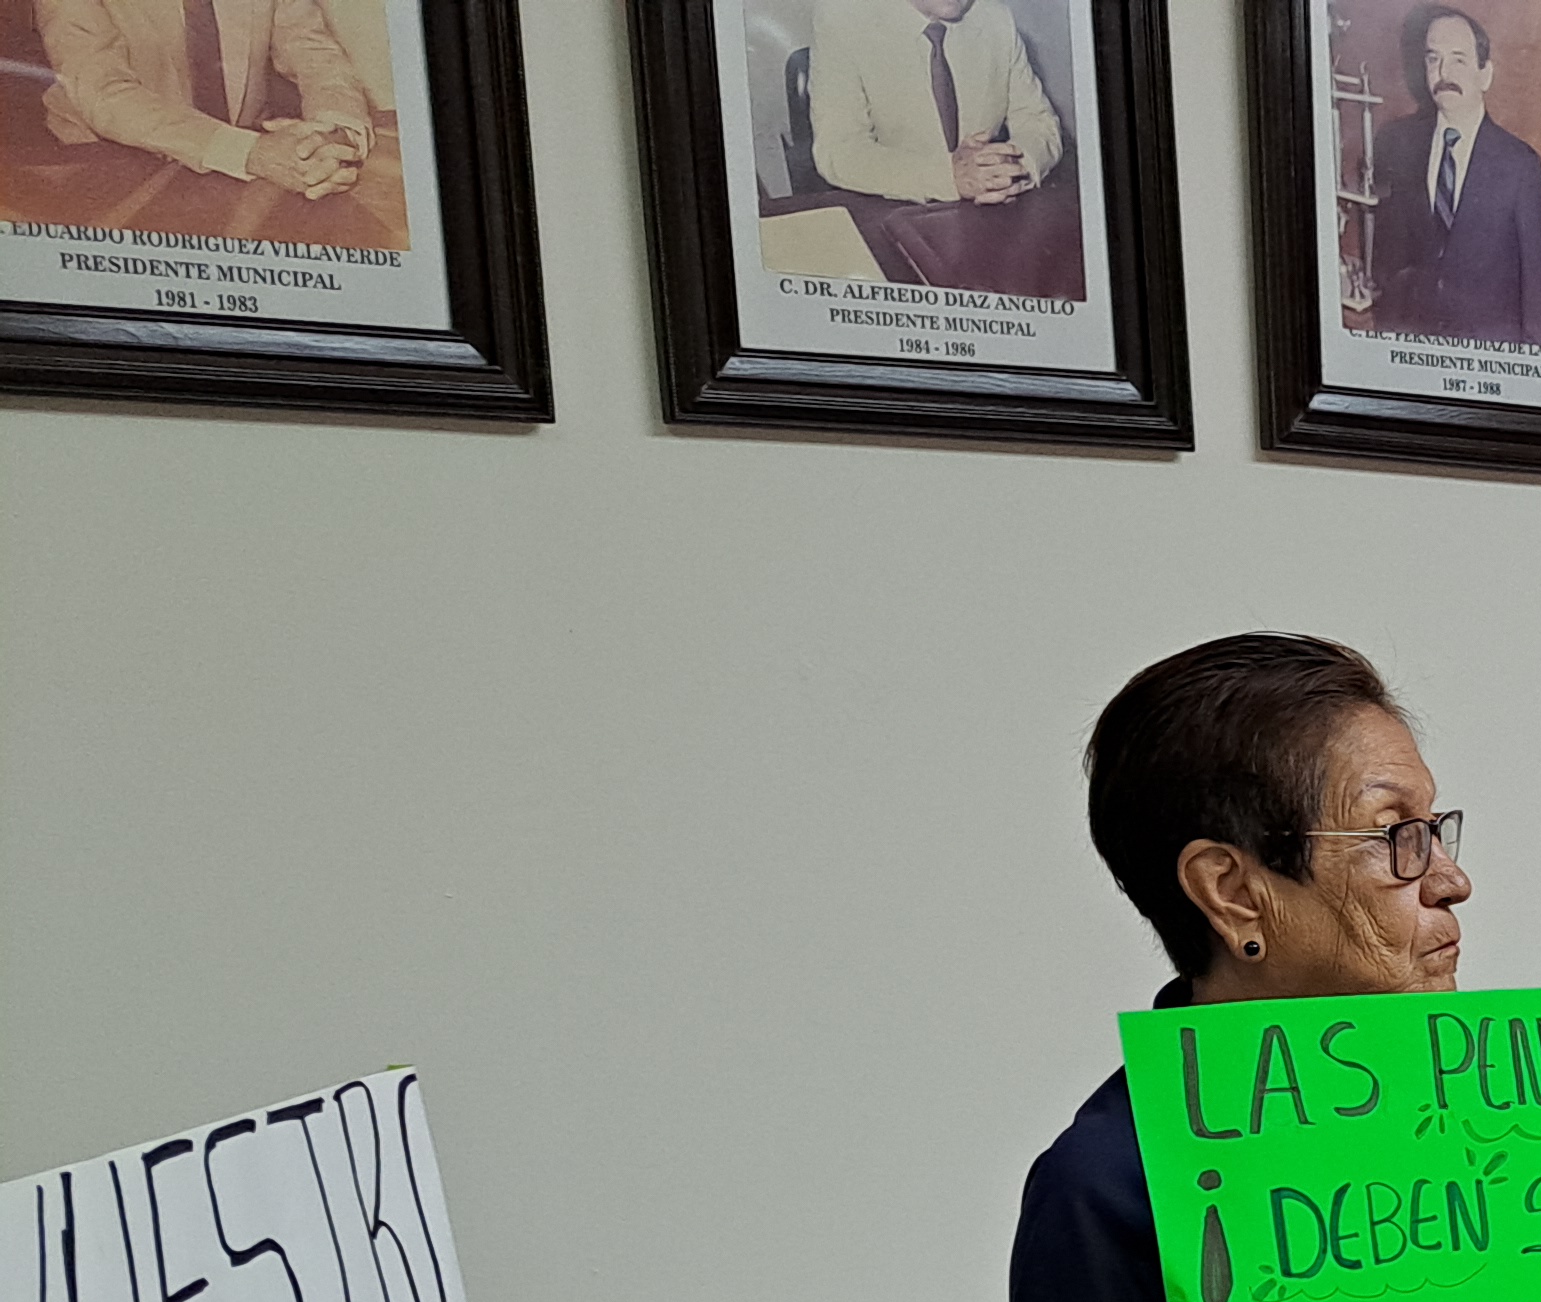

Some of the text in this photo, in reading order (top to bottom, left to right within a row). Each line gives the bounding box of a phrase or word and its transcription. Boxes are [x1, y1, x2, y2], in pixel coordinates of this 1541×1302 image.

[13, 222, 402, 268] EDUARDO RODRIGUEZ VILLAVERDE
[60, 252, 343, 291] PRESIDENTE MUNICIPAL
[154, 289, 197, 309] 1981
[217, 295, 260, 313] 1983
[780, 278, 1076, 316] C. DR. ALFREDO DIAZ ANGULO
[829, 308, 1037, 338] PRESIDENTE MUNICIPAL
[898, 338, 931, 355] 1984
[944, 341, 977, 358] 1986
[1390, 350, 1475, 372] PRESIDENTE
[1442, 377, 1467, 392] 1987
[1476, 380, 1502, 396] 1988
[1179, 1021, 1381, 1140] LAS
